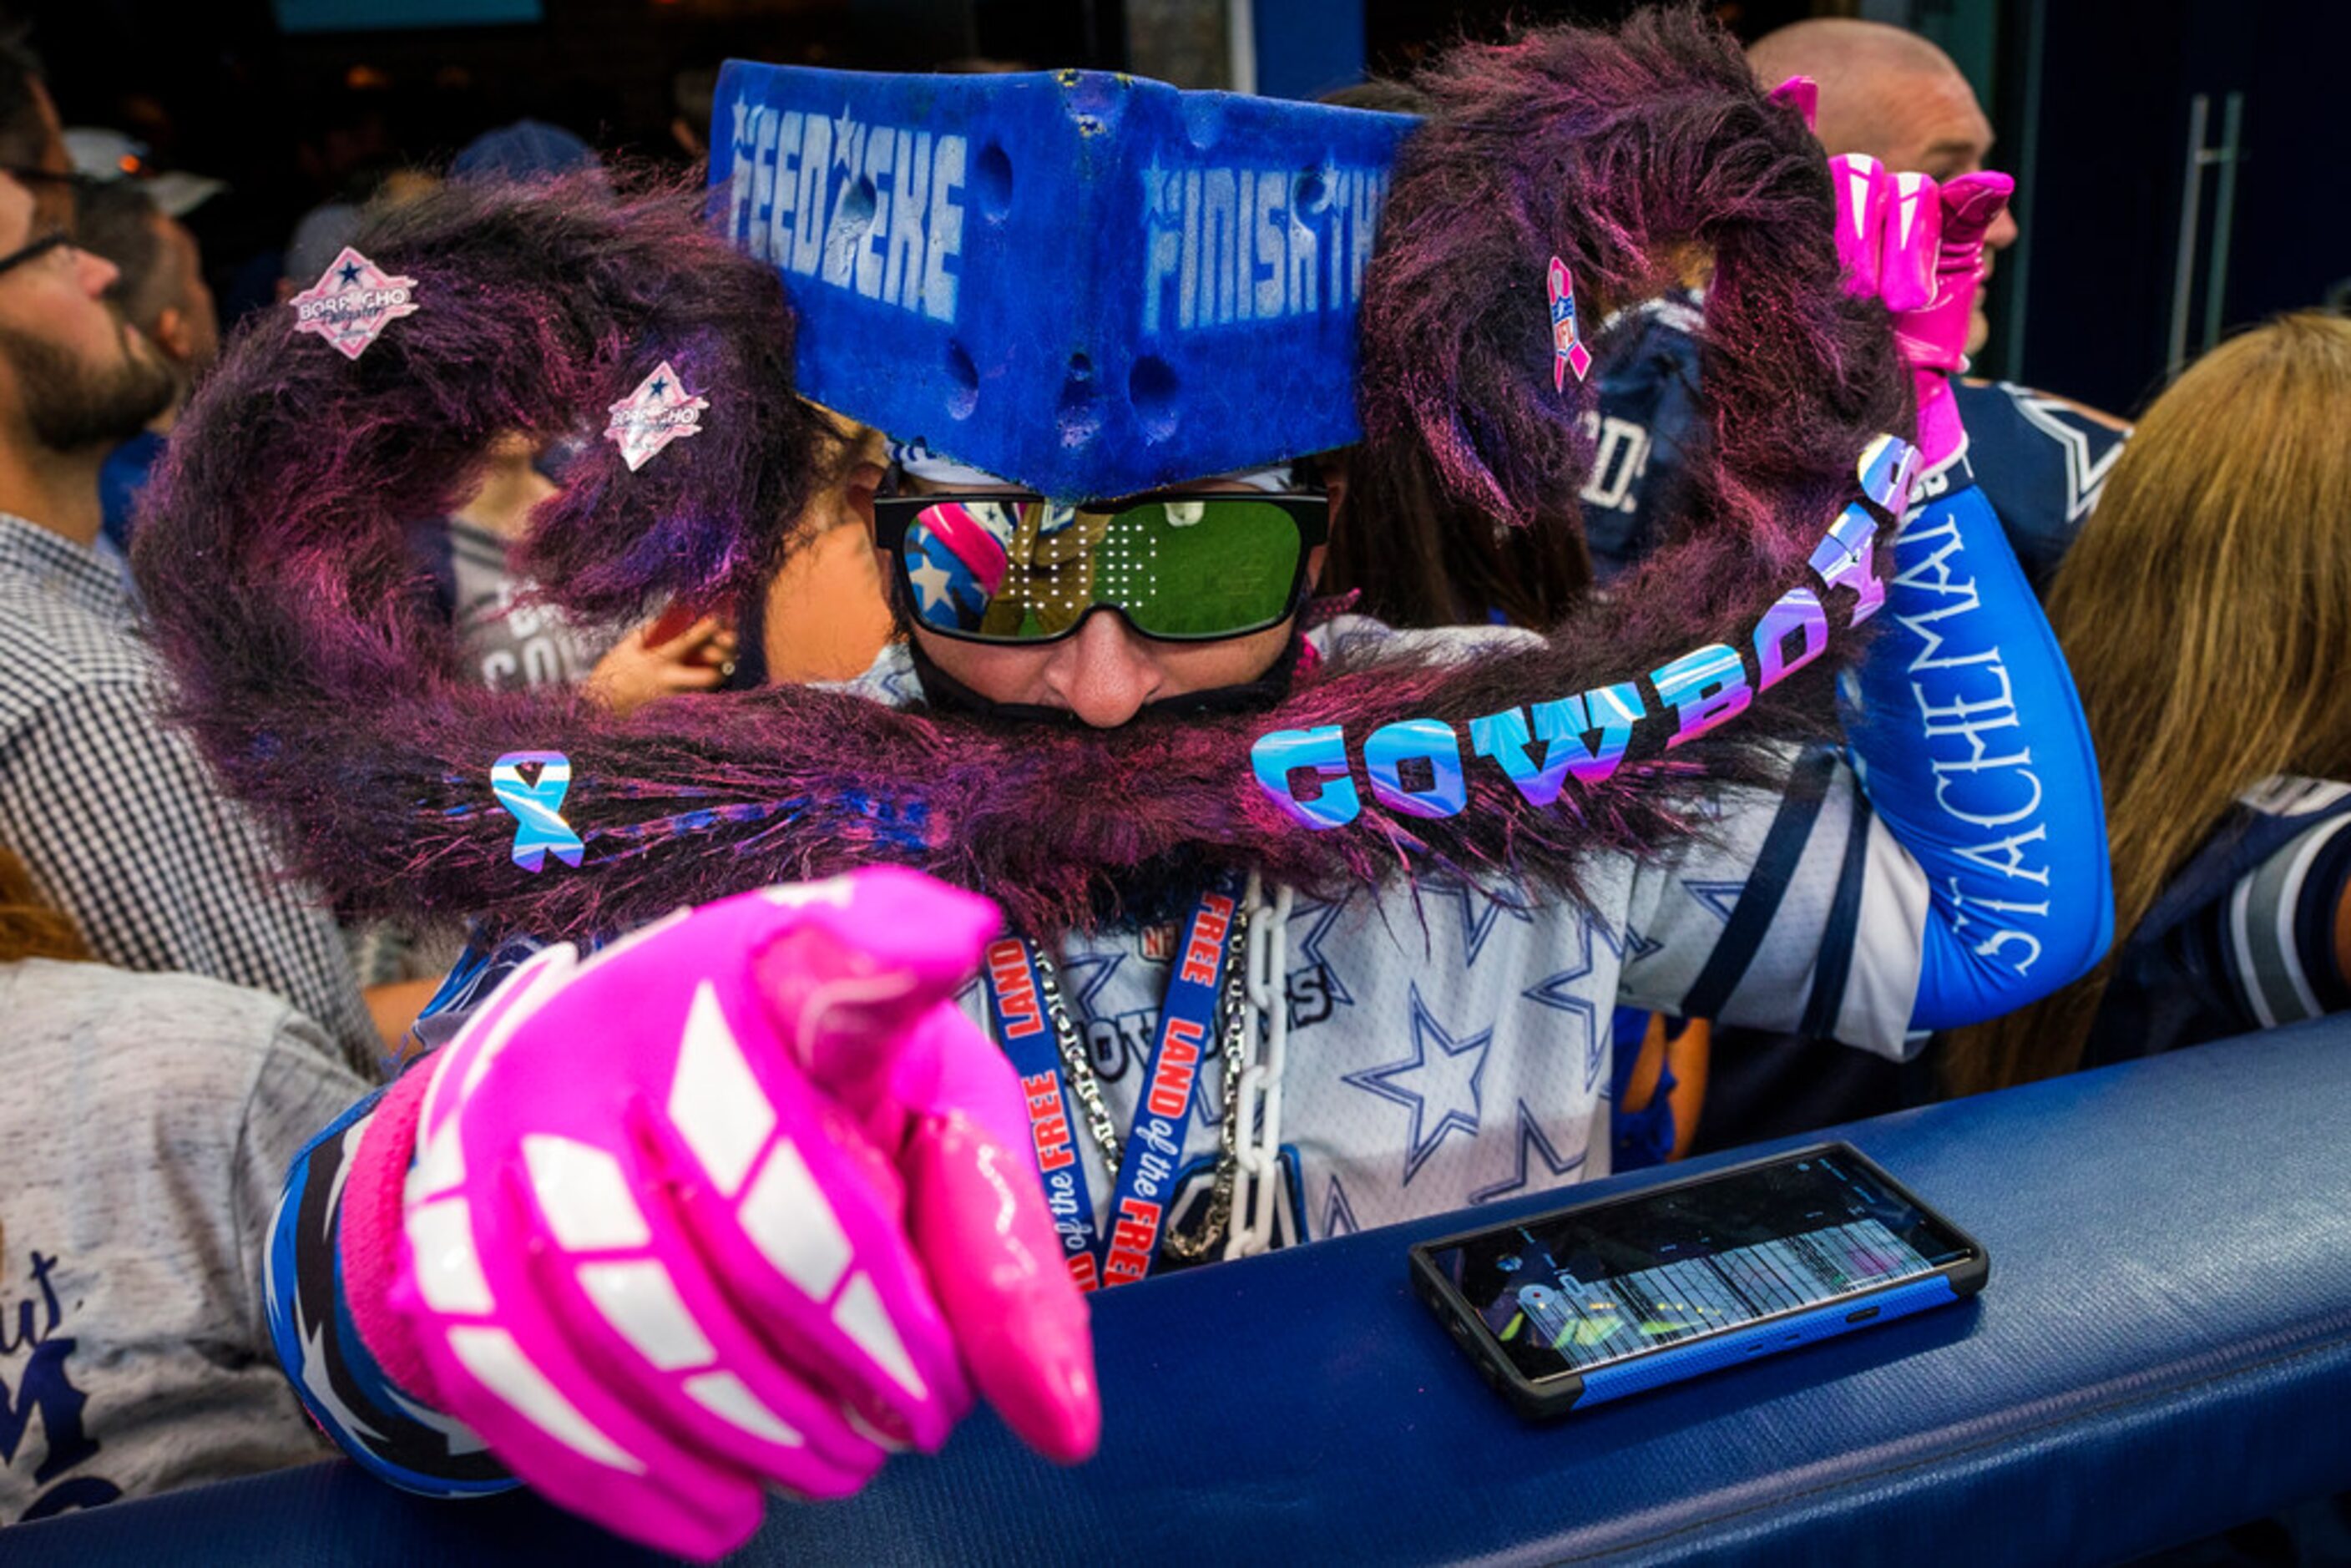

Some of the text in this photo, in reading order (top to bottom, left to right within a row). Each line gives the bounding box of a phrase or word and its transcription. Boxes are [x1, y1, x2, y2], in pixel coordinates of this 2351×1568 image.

[728, 89, 968, 325] FEED ZEKE
[1139, 149, 1391, 335] FINISH TH
[299, 287, 407, 321] BORRCHO
[1250, 432, 1927, 832] COWBOYS
[986, 937, 1044, 1040] LAND
[1181, 890, 1235, 988] FREE
[1147, 1016, 1204, 1120] LAND
[1020, 1070, 1076, 1173] FREE
[1135, 1119, 1179, 1156] of
[1049, 1170, 1079, 1216] the
[1134, 1153, 1171, 1197] the
[1054, 1217, 1094, 1250] of
